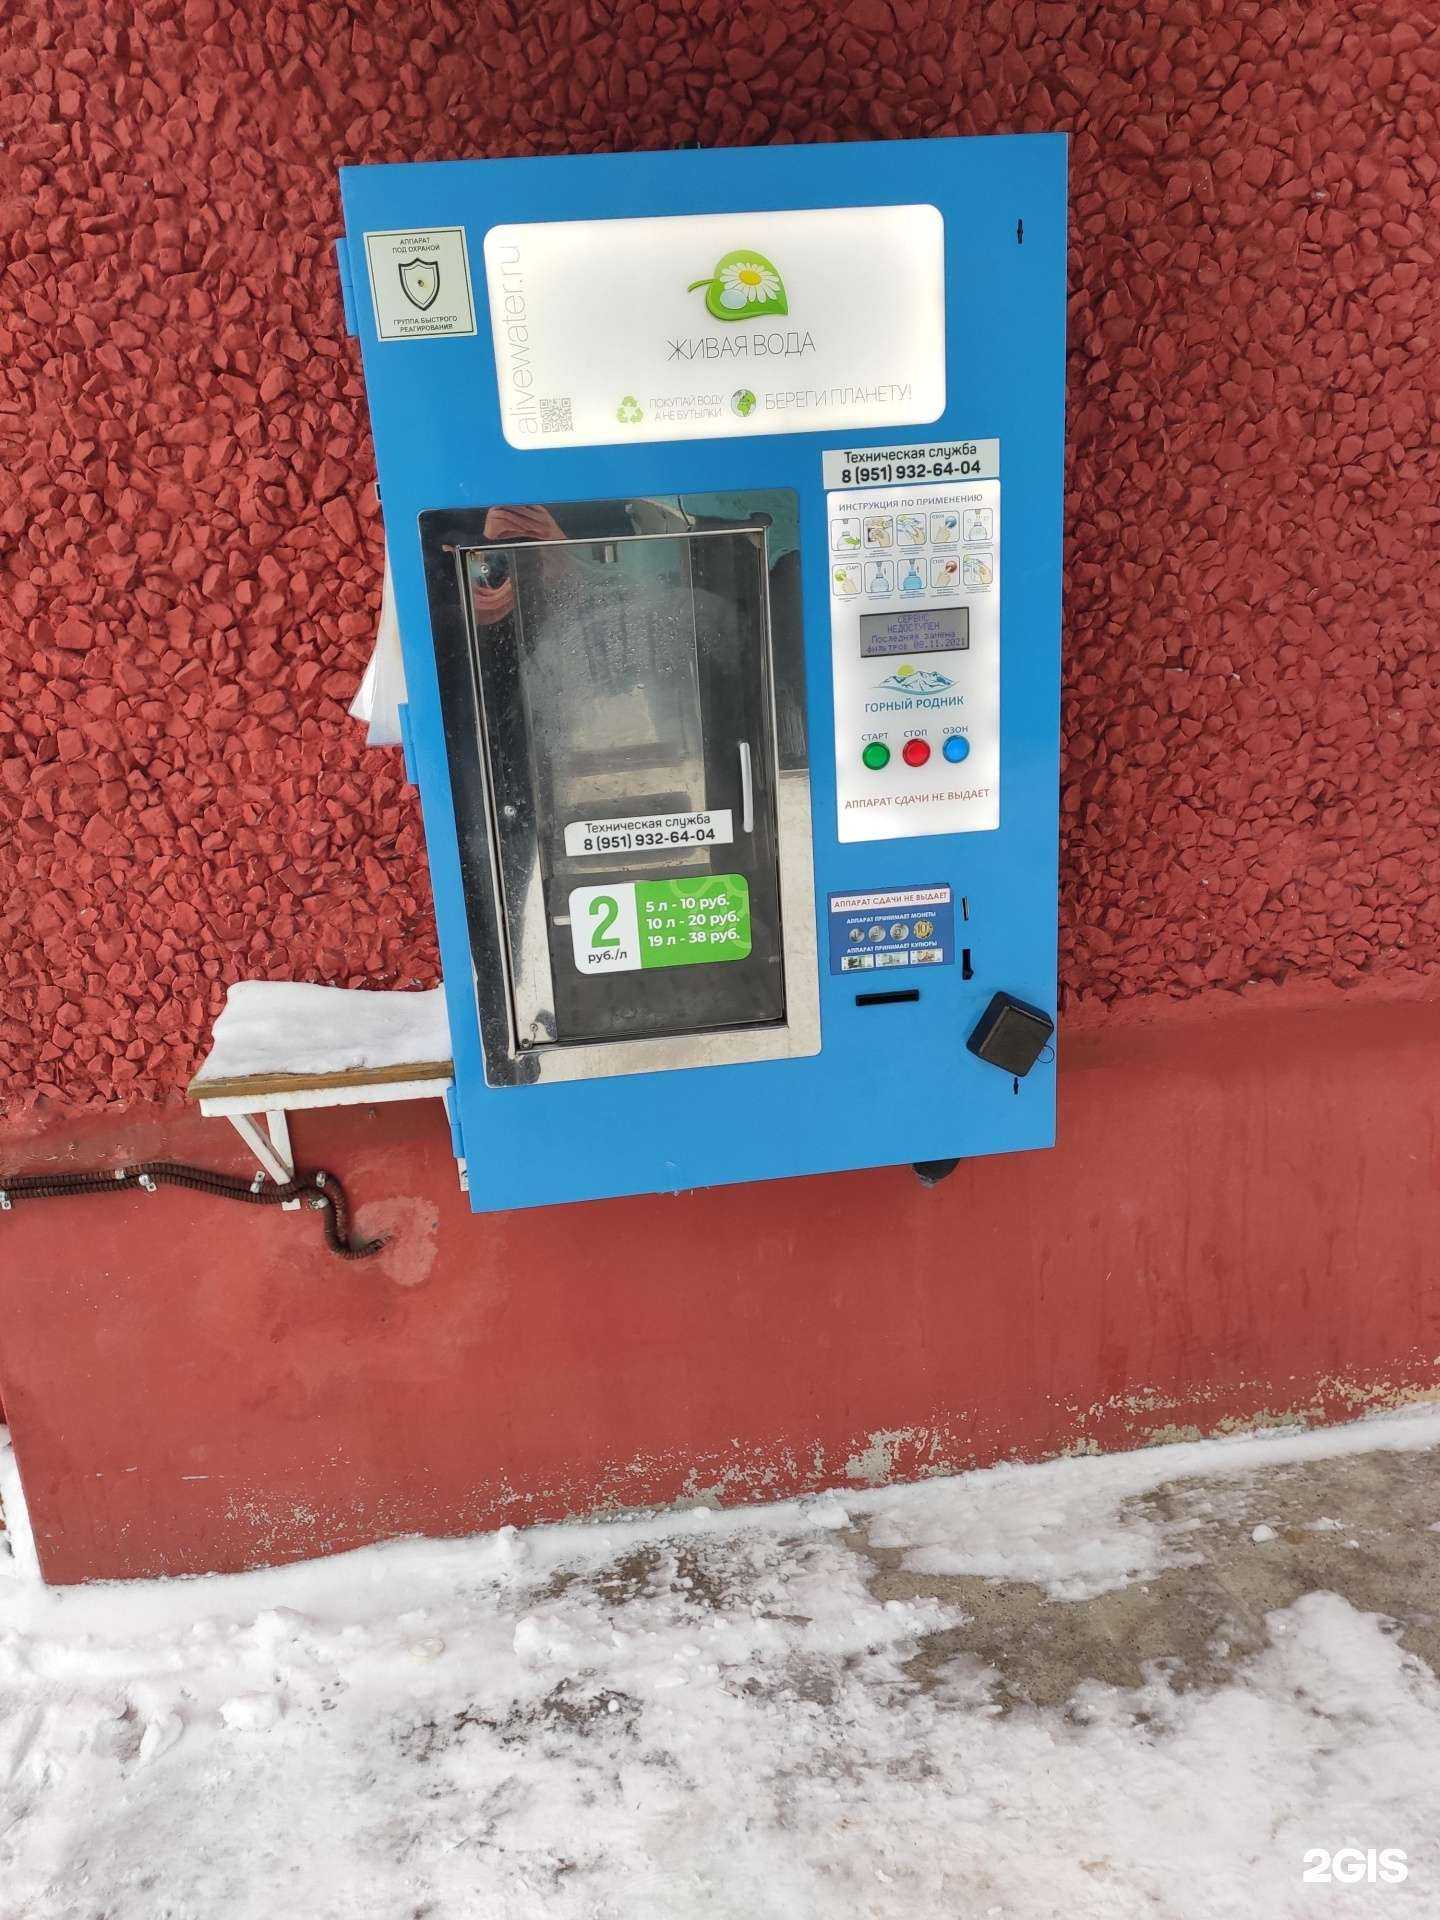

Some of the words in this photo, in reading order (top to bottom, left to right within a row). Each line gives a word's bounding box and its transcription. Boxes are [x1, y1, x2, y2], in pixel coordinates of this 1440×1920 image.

[400, 237, 430, 245] АППАРАТ
[392, 246, 407, 254] ПОД
[408, 244, 440, 253] ОХРАНОЙ
[393, 317, 419, 326] ГРУППА
[420, 315, 458, 324] БЫСТРОГО
[400, 323, 453, 333] РЕАГИРОВАНИЯ
[499, 246, 538, 434] alivewater.ru
[667, 336, 748, 360] ЖИВАЯ
[753, 331, 816, 358] ВОДА
[650, 394, 696, 408] ПОКУПАЙ
[697, 394, 723, 406] ВОДУ
[765, 389, 827, 410] БЕРЕГИ
[831, 383, 912, 405] ПЛАНЕТУ!
[663, 409, 675, 420] НЕ
[677, 408, 721, 420] БУТЫЛКИ
[844, 448, 925, 464] Техническая
[929, 443, 977, 461] служба
[842, 470, 852, 484] 8
[855, 467, 892, 485] (951)
[896, 460, 981, 480] 932-64-04
[839, 499, 899, 512] ИНСТРУКЦИЯ
[901, 499, 914, 507] ПО
[916, 494, 983, 506] ПРИМЕНЕНИЮ
[898, 613, 929, 623] СЕРВИС
[888, 621, 940, 633] НЕДОСТУПЕН
[865, 697, 912, 713] ГОРНЫЙ
[916, 696, 964, 711] РОДНИК
[861, 732, 889, 742] СТАРТ
[904, 729, 928, 738] СТОП
[942, 726, 969, 735] ОЗОН
[845, 797, 891, 809] АППАРАТ
[895, 793, 929, 806] СДАЧИ
[932, 793, 945, 802] НЕ
[948, 788, 991, 801] ВЫДАЕТ
[585, 818, 662, 834] Техническая
[665, 814, 711, 830] служба
[584, 838, 593, 850] 8
[597, 833, 632, 850] (951)
[635, 828, 716, 846] 932-64-04
[646, 902, 655, 913] 5
[658, 902, 668, 912] л
[680, 898, 696, 909] 10
[699, 894, 730, 912] руб.
[834, 898, 870, 908] АППАРАТ
[872, 895, 902, 905] СДАЧИ
[904, 894, 914, 902] НЕ
[916, 892, 947, 901] ВЫДАЕТ
[588, 895, 621, 948] 2
[647, 918, 663, 929] 10
[666, 919, 676, 928] л
[688, 914, 706, 926] 20
[710, 911, 740, 928] руб.
[875, 914, 910, 922] ПРИНИМАЕТ
[911, 911, 936, 919] МОНЕТЫ
[917, 923, 927, 934] 10
[648, 935, 663, 947] 19
[666, 936, 676, 946] л
[688, 932, 707, 943] 38
[710, 928, 740, 945] руб.
[847, 946, 874, 954] АППАРАТ
[875, 943, 910, 951] ПРИНИМАЕТ
[588, 949, 628, 964] руб./л
